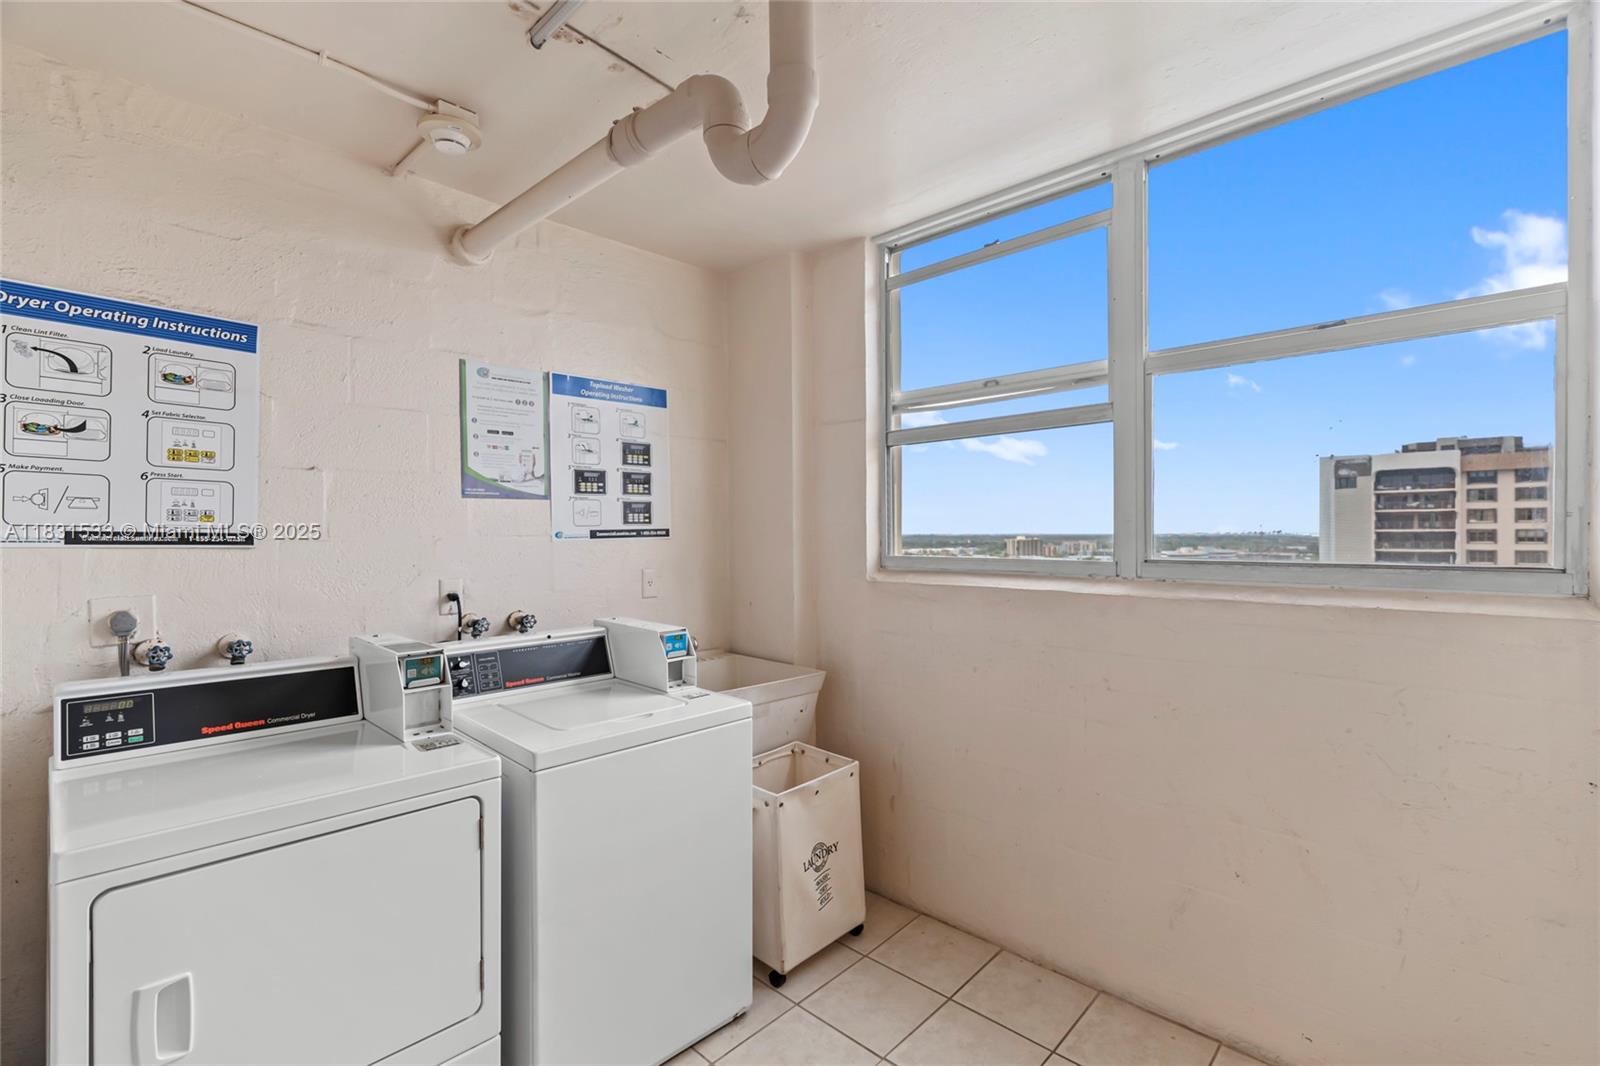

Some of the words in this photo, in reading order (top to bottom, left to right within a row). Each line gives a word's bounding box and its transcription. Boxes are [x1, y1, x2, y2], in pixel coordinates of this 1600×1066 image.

[0, 290, 50, 309] Dryer
[54, 300, 149, 329] Operating
[152, 317, 248, 343] Instructions
[1, 325, 7, 333] 1
[10, 325, 33, 333] Clean
[142, 345, 151, 355] 2
[0, 393, 7, 402] 3
[580, 389, 610, 399] Operating
[141, 409, 150, 418] 4
[0, 463, 6, 472] 5
[140, 471, 149, 480] 6
[201, 723, 234, 734] Speed
[234, 719, 265, 729] Queen
[266, 714, 300, 724] Commercial
[300, 711, 316, 719] Dryer
[803, 841, 839, 872] LAUNDRY
